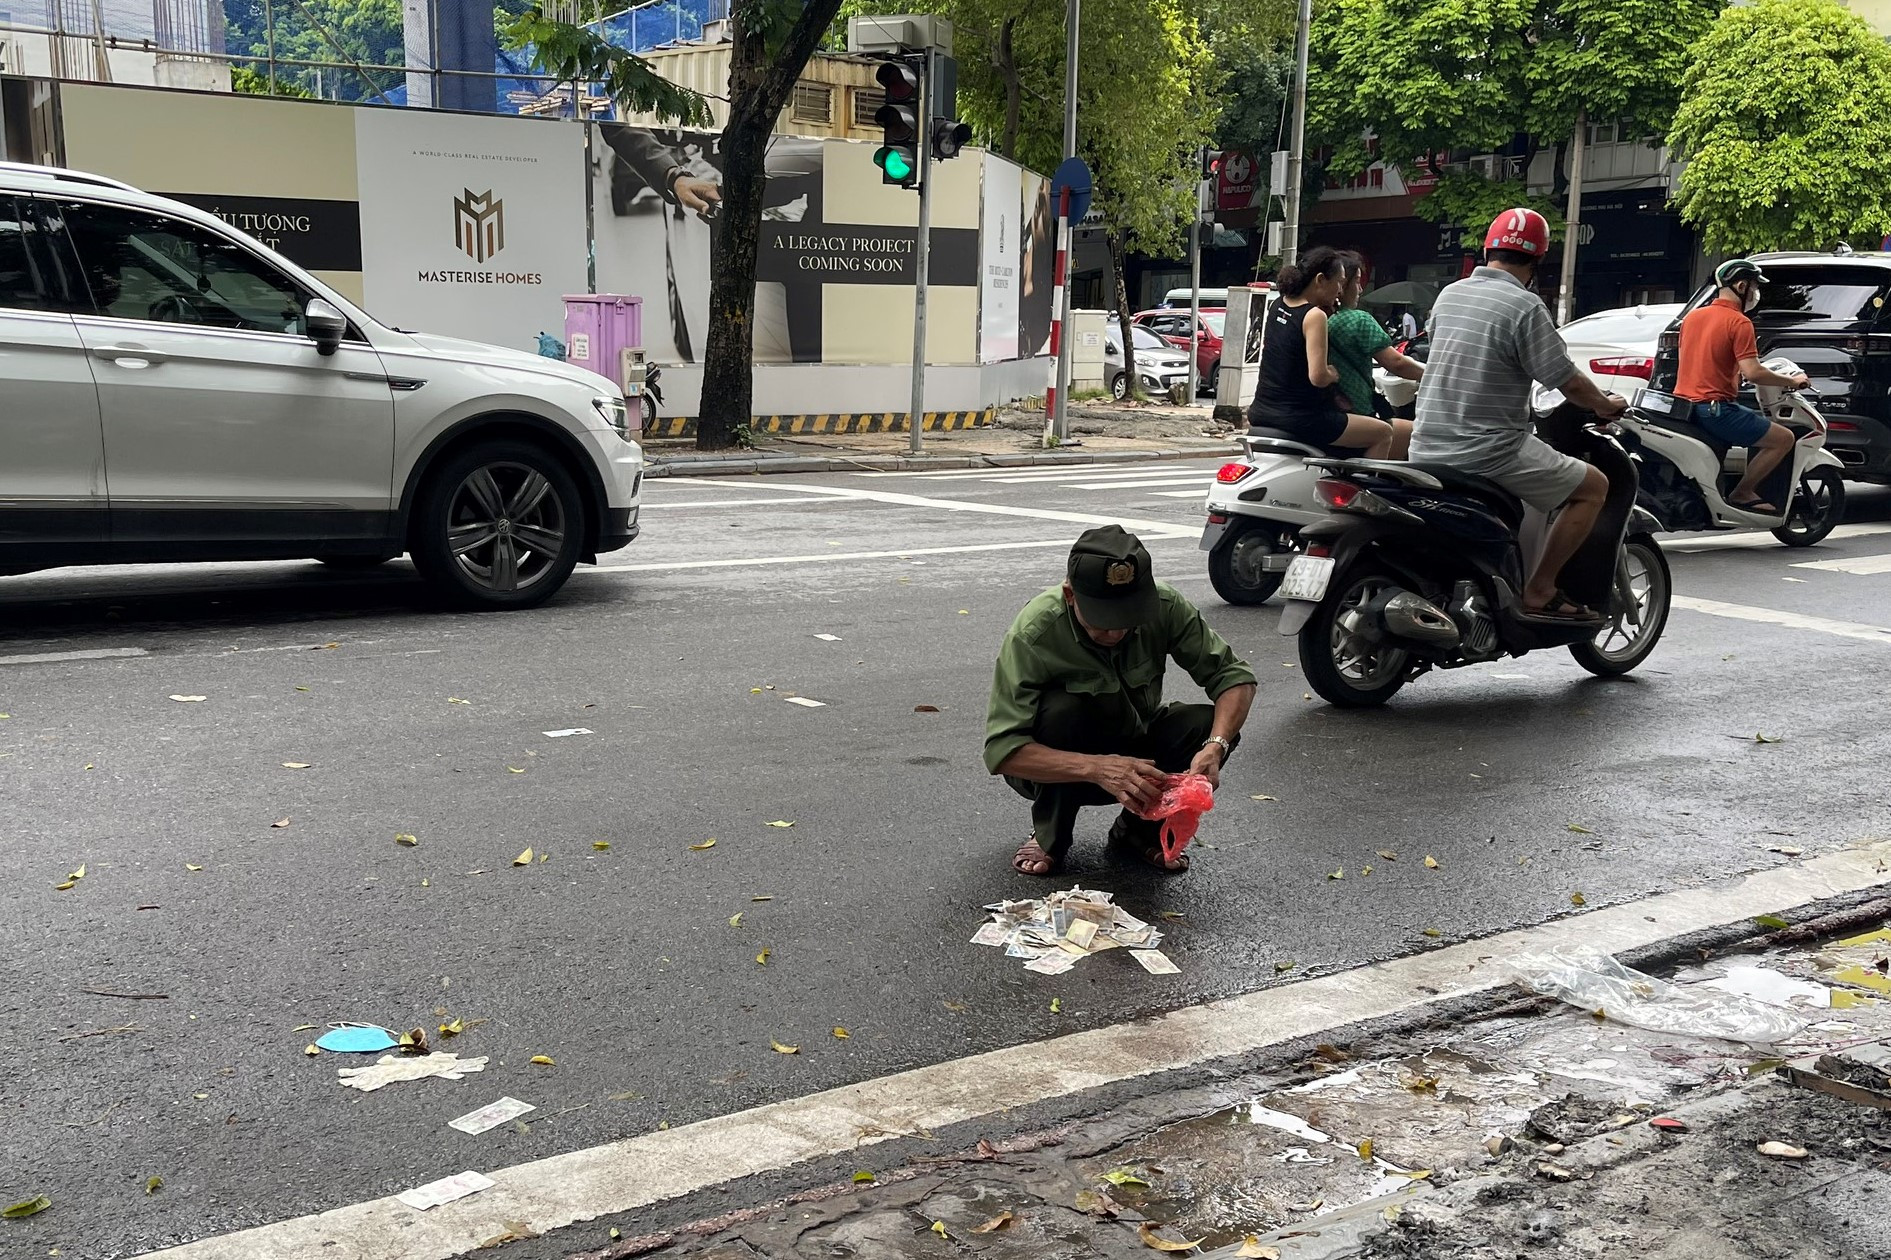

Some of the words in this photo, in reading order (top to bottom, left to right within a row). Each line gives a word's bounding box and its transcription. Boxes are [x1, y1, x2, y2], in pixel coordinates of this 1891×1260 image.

[240, 213, 311, 234] TƯỢNG
[773, 235, 784, 249] A
[789, 236, 848, 251] LEGACY
[852, 238, 915, 253] PROJECT
[799, 256, 859, 271] COMING
[863, 258, 904, 272] SOON
[418, 271, 493, 284] MASTERISE
[495, 273, 542, 285] HOMES
